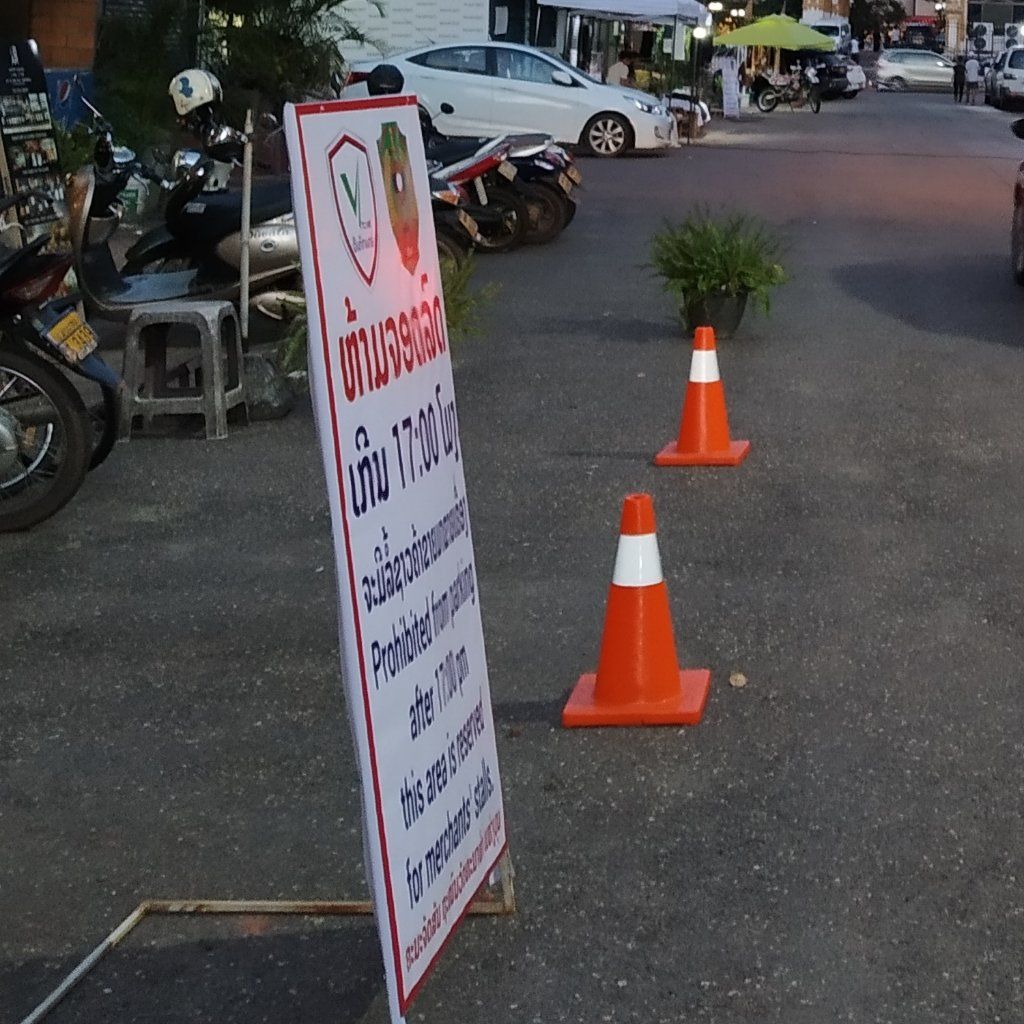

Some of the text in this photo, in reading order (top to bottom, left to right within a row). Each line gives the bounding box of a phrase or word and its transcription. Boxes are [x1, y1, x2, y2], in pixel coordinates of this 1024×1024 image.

[392, 403, 440, 489] 17:00
[371, 561, 476, 689] Prohibited from parking
[410, 684, 434, 740] after
[456, 646, 470, 697] pm
[401, 687, 484, 830] this area is reserved
[406, 858, 423, 909] for
[425, 784, 473, 888] merchants'
[474, 756, 494, 819] stalls.
